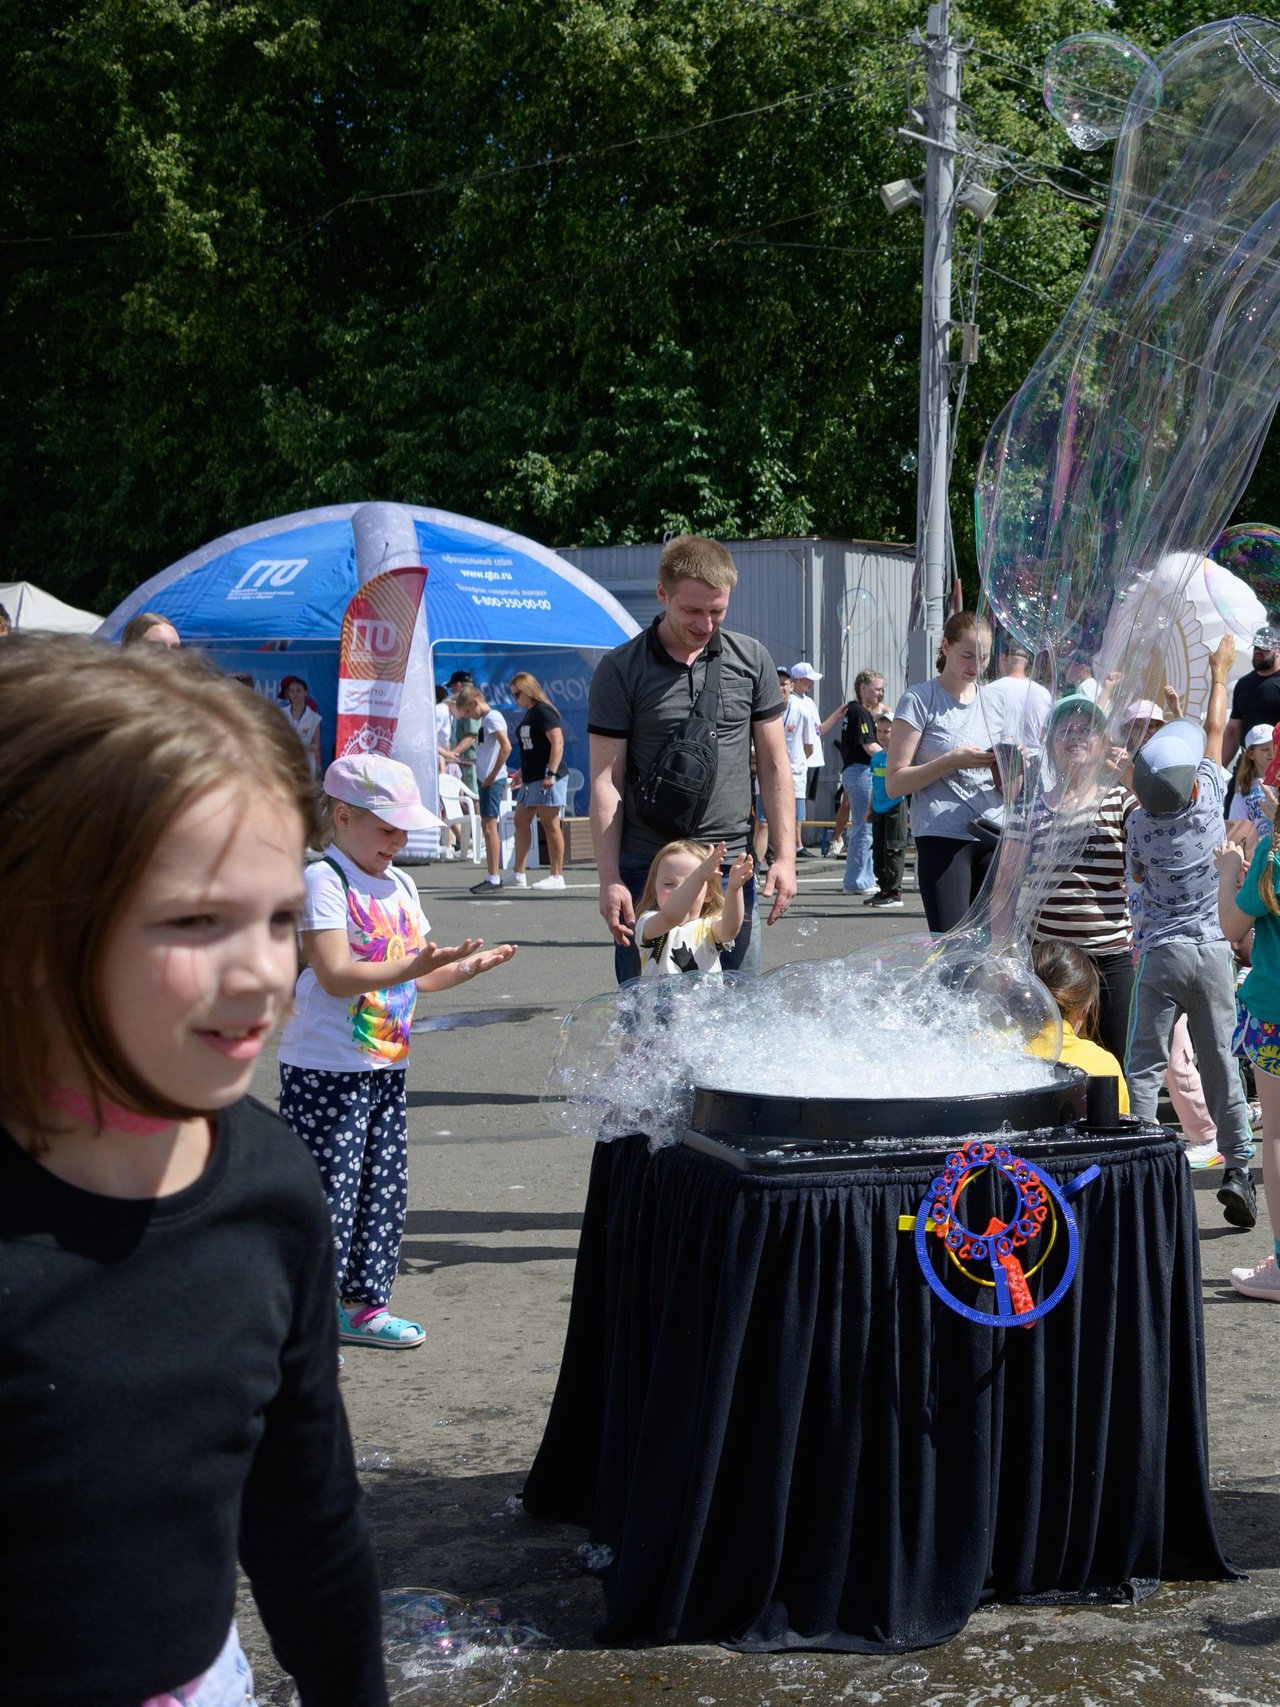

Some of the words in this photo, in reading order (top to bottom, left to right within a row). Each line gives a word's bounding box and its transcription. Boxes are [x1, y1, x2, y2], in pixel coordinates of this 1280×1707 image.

[235, 558, 308, 589] ГТО
[460, 569, 513, 581] www.gto.ru
[472, 595, 551, 610] 8-800-350-00-00
[350, 618, 397, 652] ГТО
